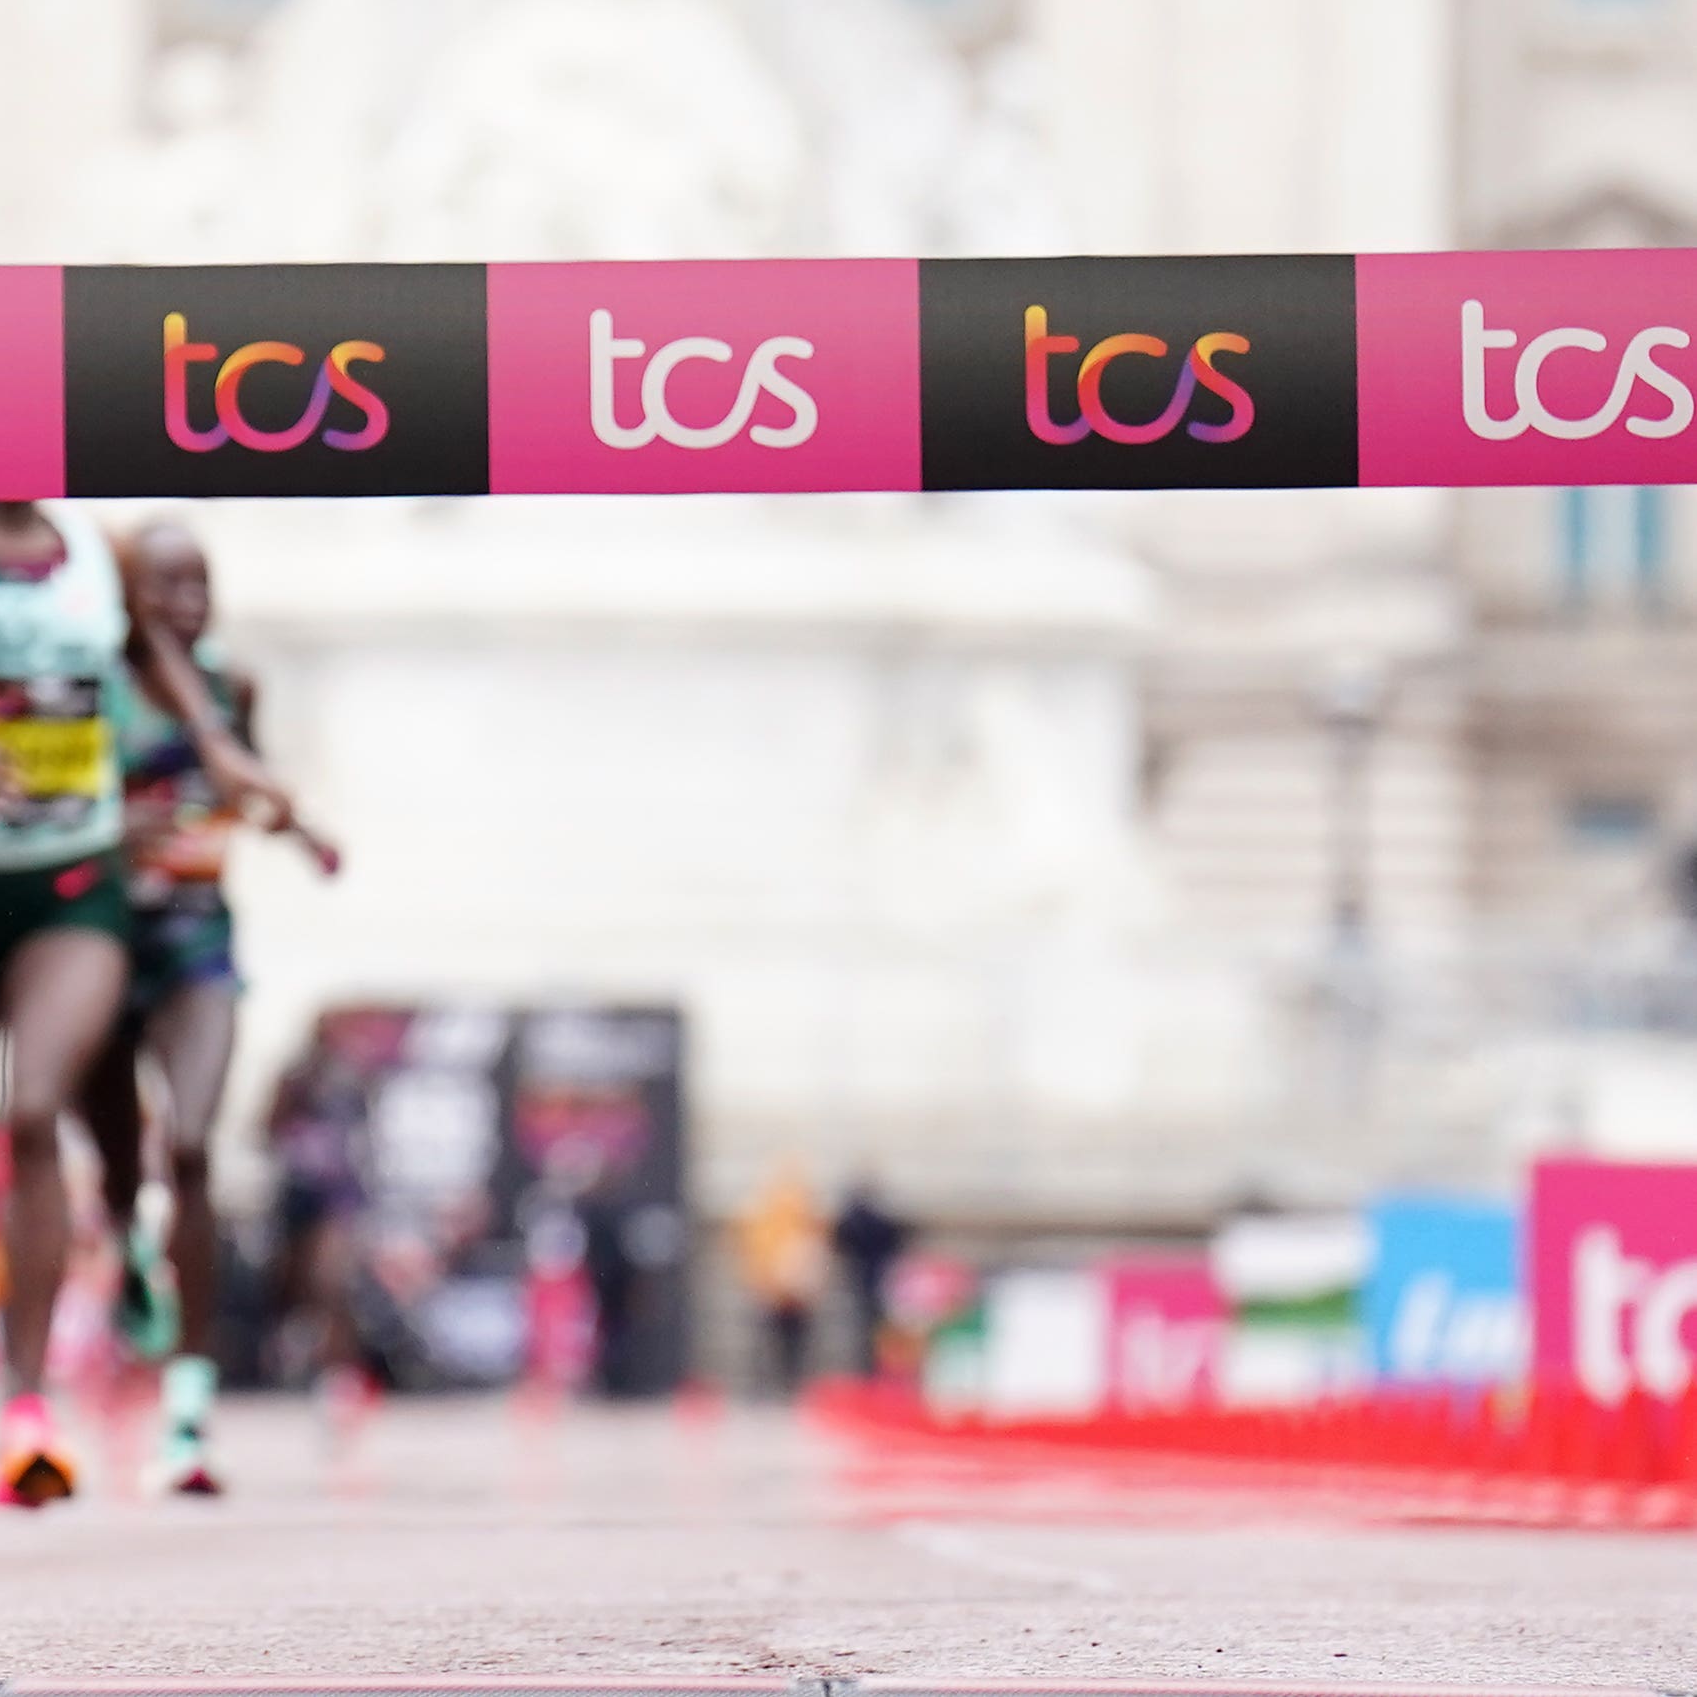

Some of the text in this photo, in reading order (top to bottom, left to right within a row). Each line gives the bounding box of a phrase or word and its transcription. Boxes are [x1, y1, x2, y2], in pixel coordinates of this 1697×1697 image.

[163, 312, 390, 453] tcs
[589, 308, 819, 449] tcs
[1024, 304, 1256, 445] tcs
[1461, 299, 1695, 440] tcs
